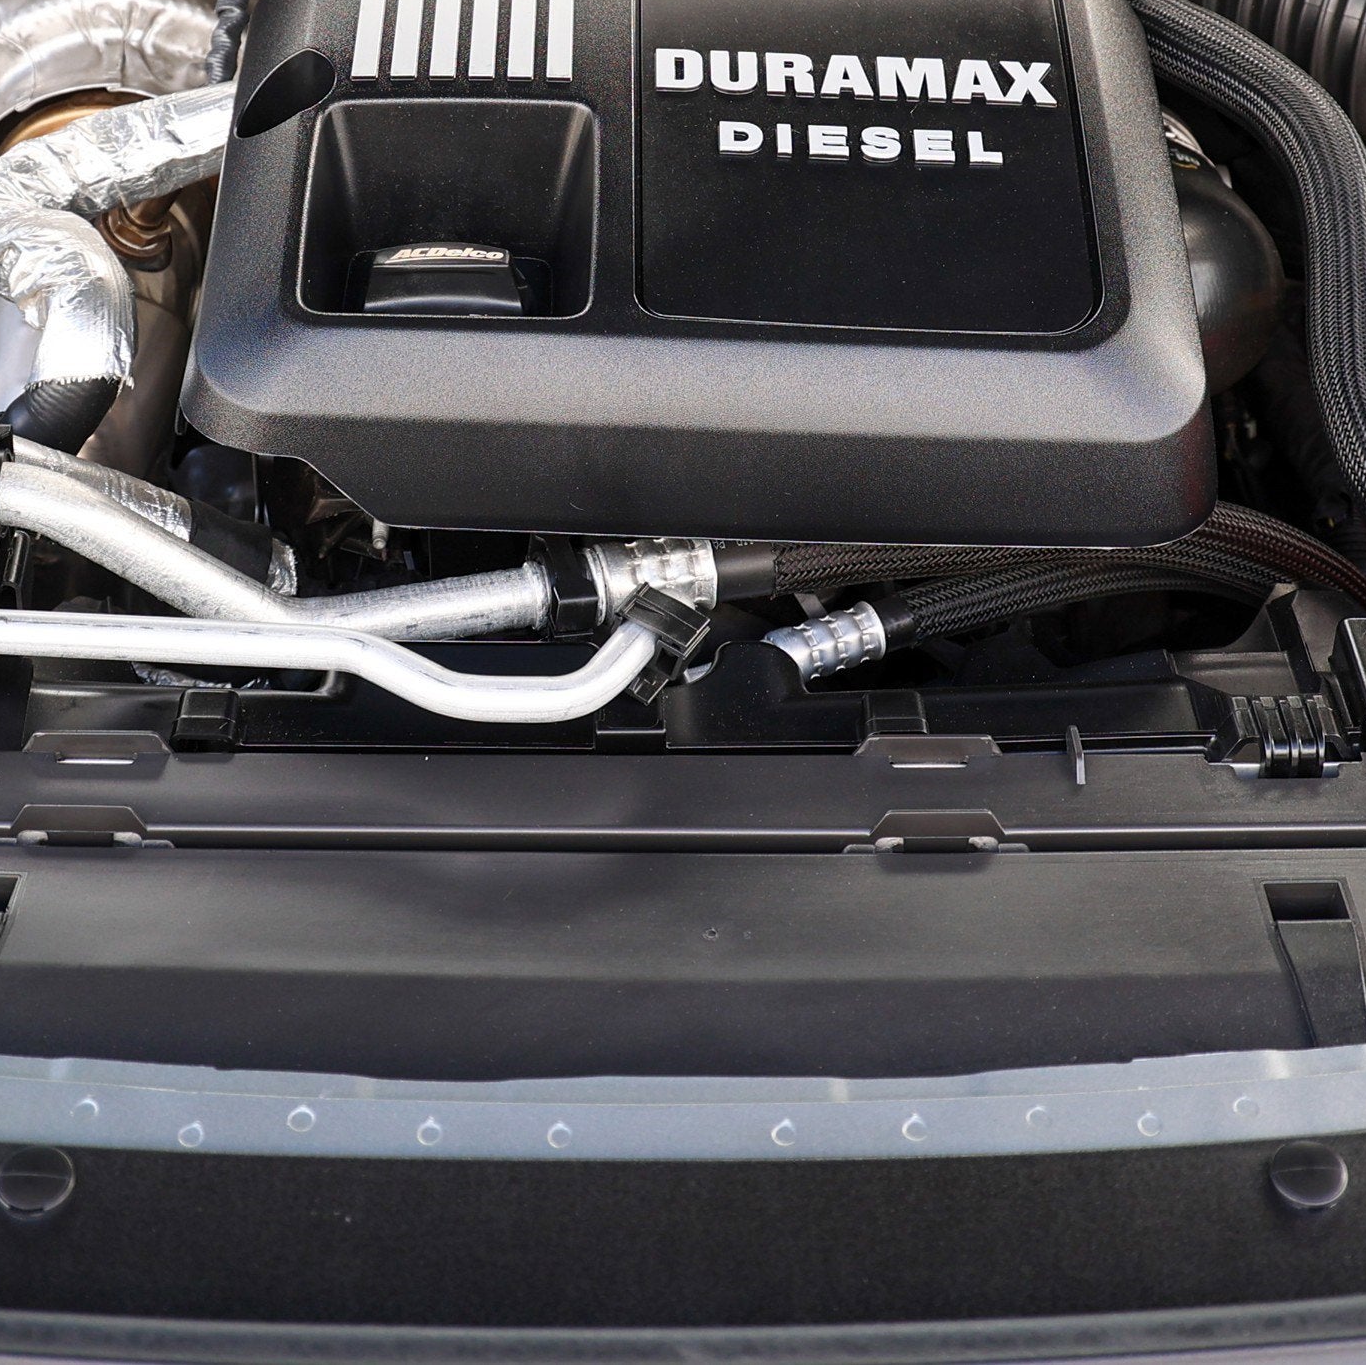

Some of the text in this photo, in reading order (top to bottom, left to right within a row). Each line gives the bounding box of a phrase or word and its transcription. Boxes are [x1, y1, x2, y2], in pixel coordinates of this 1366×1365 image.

[655, 47, 1058, 108] DURAMAX
[718, 120, 1005, 164] DIESEL
[390, 247, 504, 260] ACDelco
